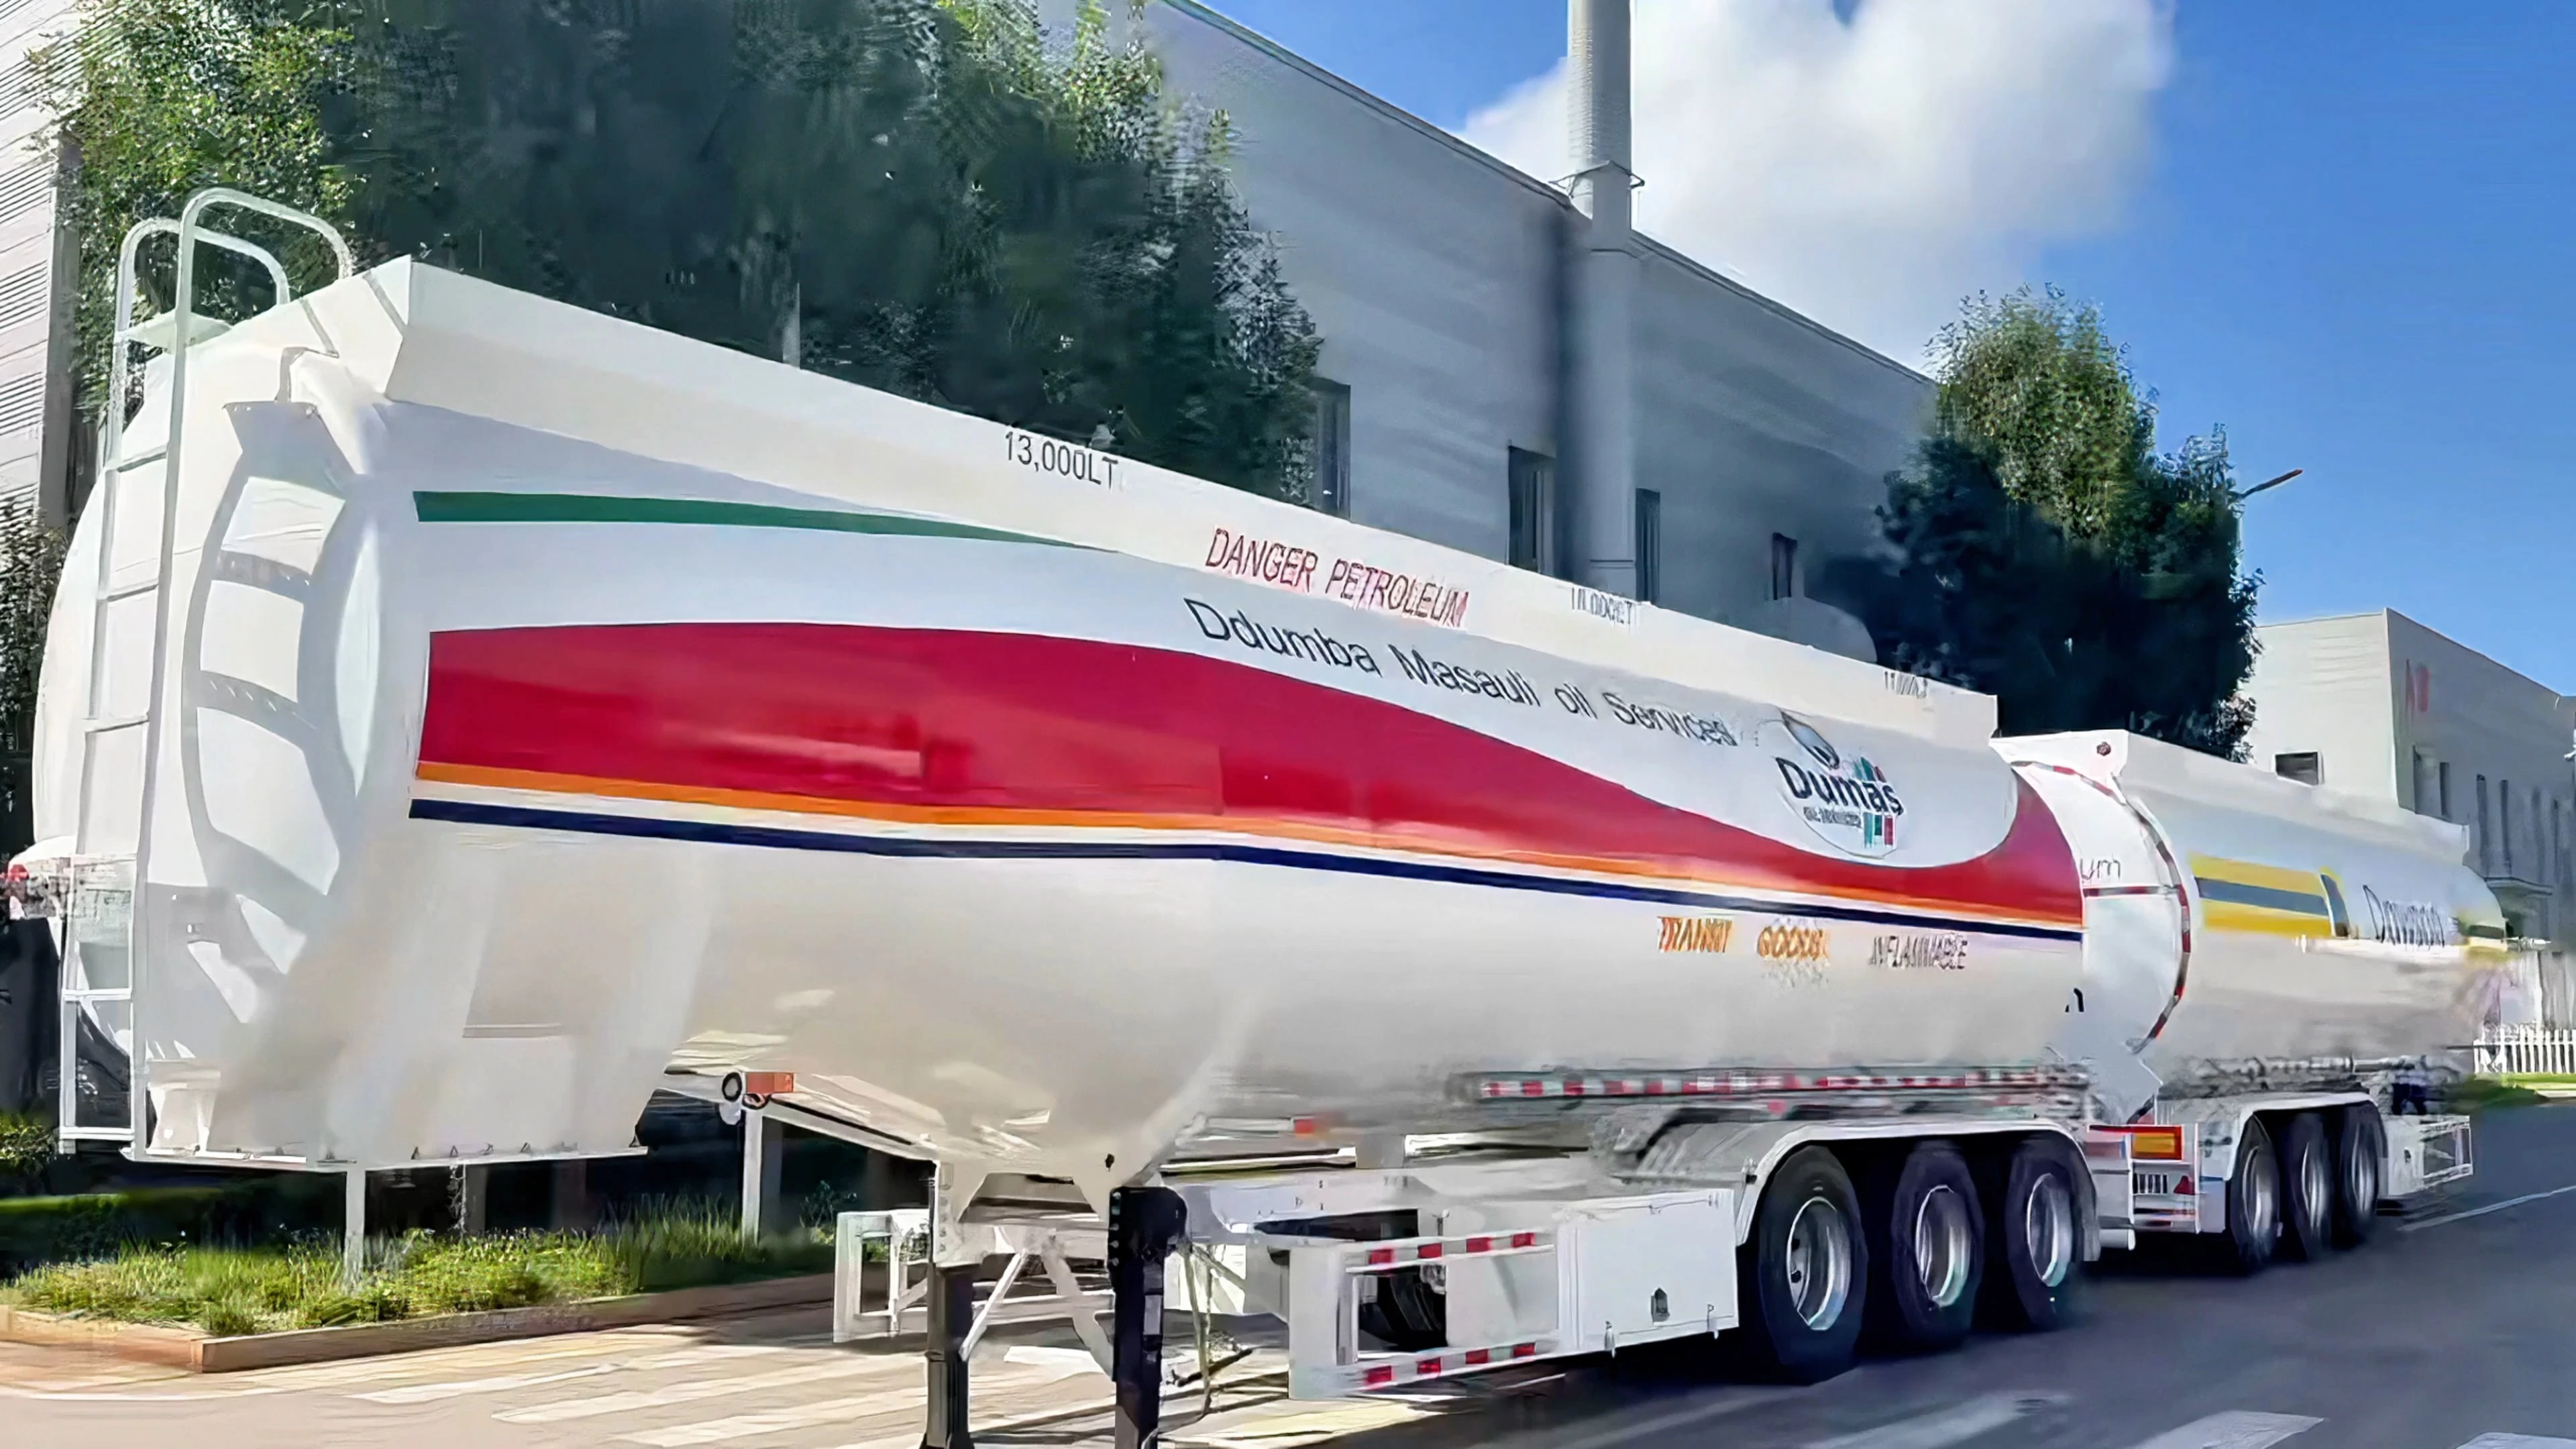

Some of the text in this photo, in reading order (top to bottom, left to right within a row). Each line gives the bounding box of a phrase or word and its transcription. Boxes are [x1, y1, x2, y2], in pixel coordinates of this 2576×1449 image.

[1005, 431, 1119, 490] 13,000LT
[1205, 527, 1470, 628] DANGER PETROLEUM
[1183, 597, 1383, 679] Ddumba
[1775, 756, 1905, 816] Dumas
